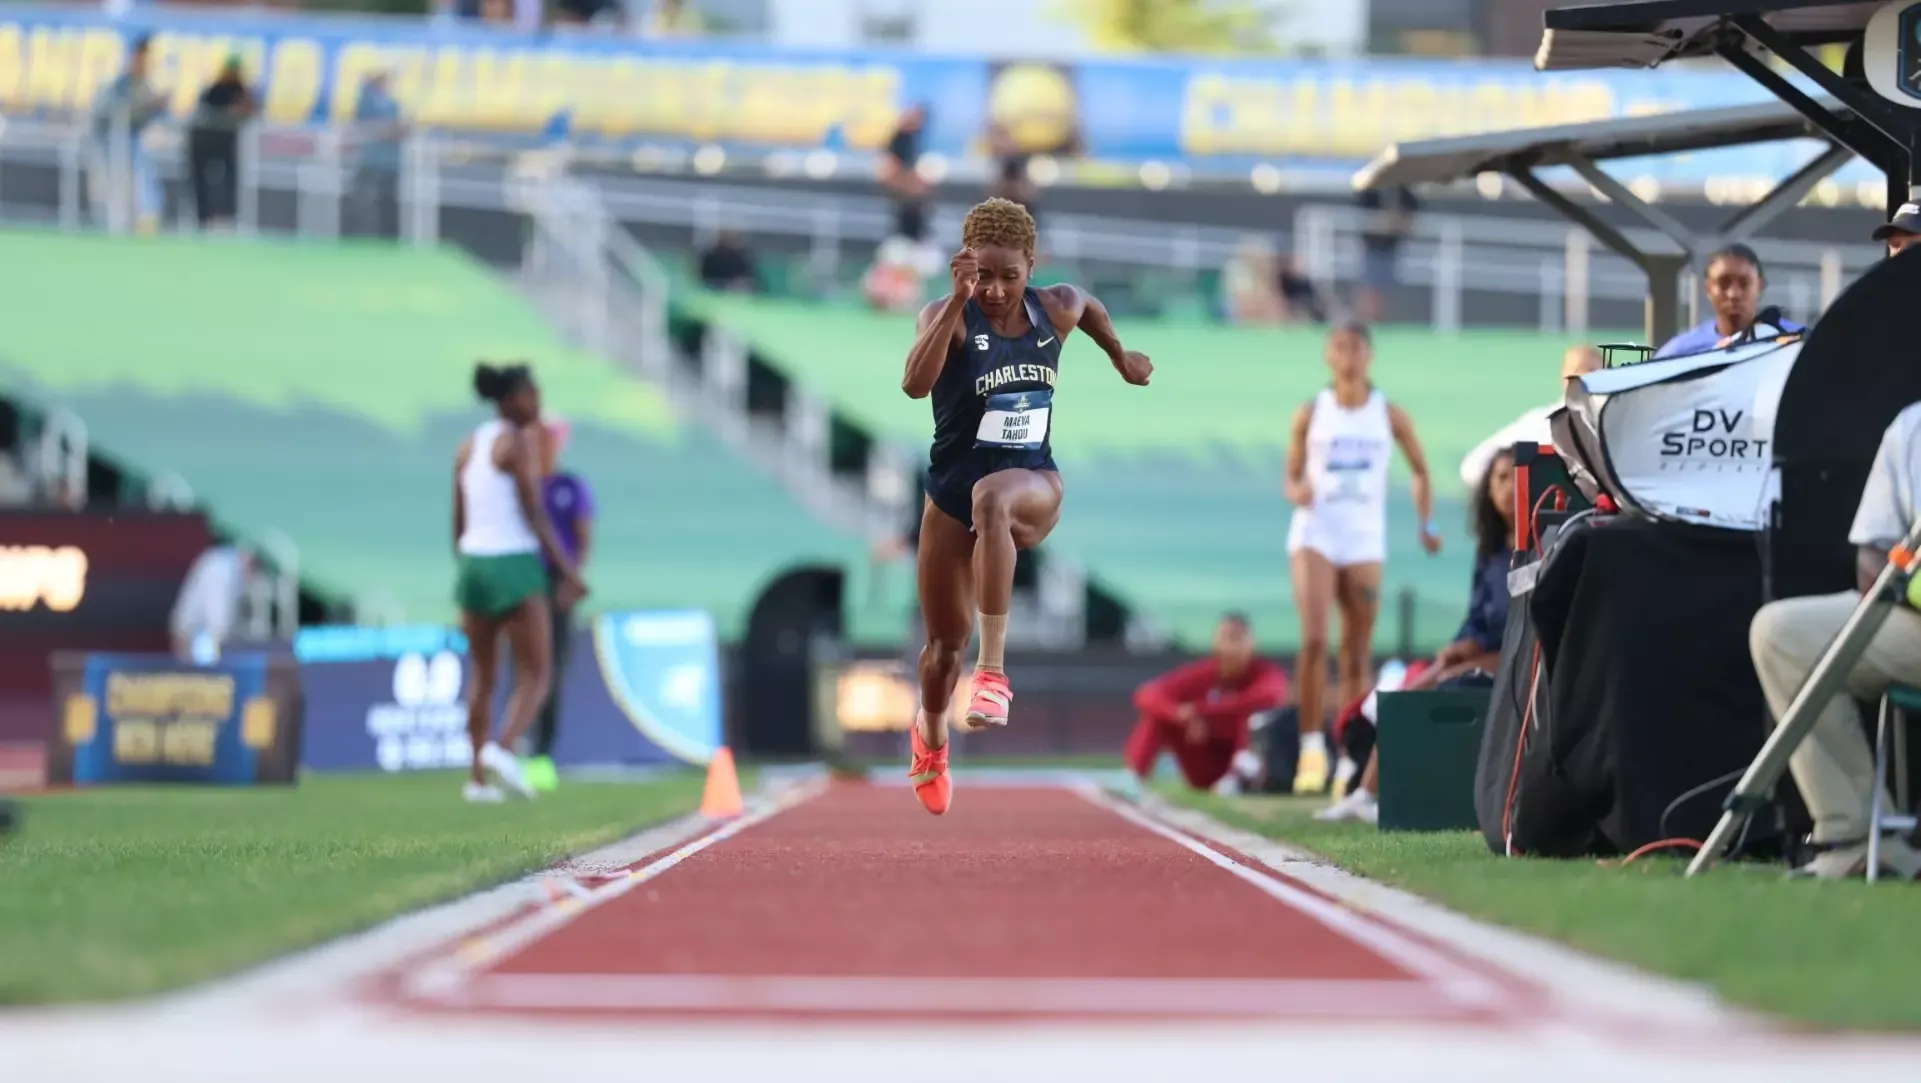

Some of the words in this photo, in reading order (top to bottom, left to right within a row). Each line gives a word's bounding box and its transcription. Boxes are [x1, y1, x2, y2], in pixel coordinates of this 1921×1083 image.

[975, 363, 1058, 396] CHARLESTON
[1001, 427, 1029, 441] TAHOU
[1003, 414, 1030, 428] MAEVA
[1692, 408, 1744, 434] DV
[1659, 432, 1768, 459] SPORT
